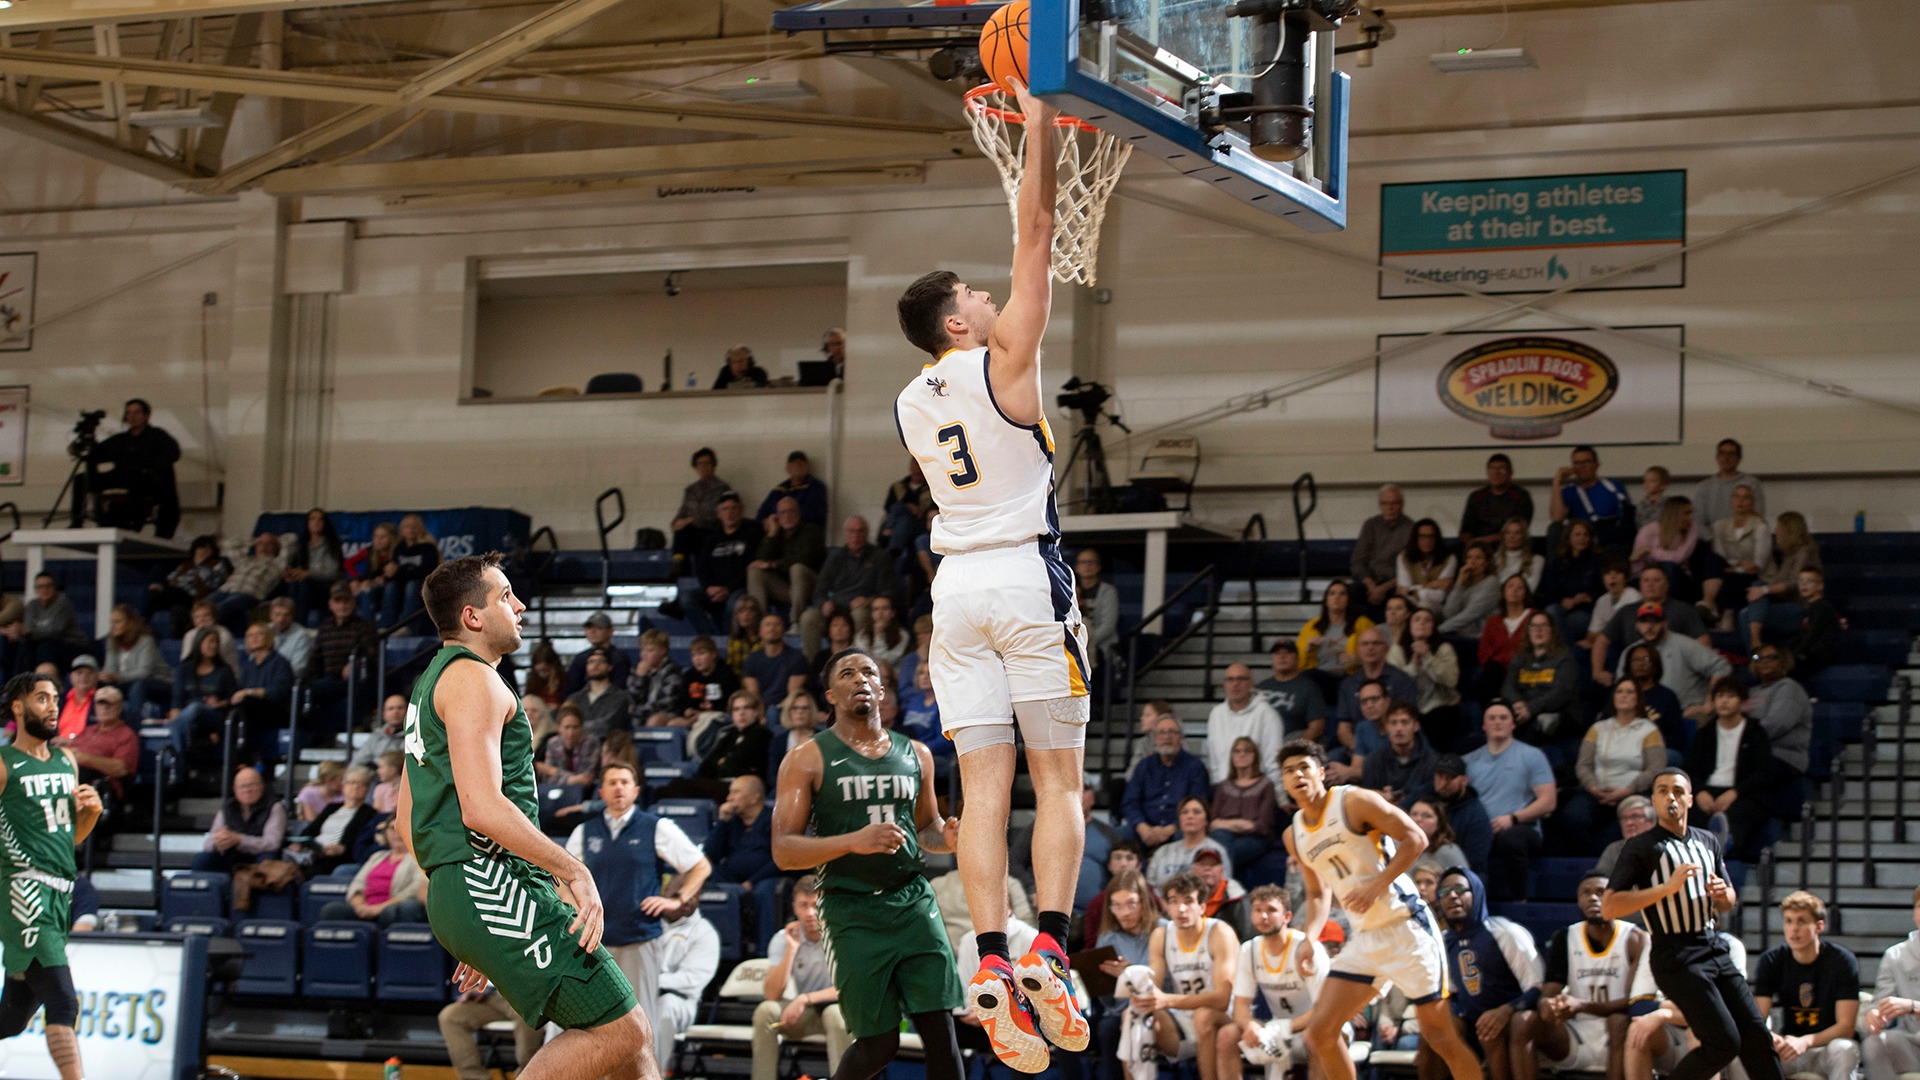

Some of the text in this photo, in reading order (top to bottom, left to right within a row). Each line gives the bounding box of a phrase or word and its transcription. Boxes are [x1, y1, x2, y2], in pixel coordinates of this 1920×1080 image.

[1421, 182, 1644, 216] Keeping athletes
[1447, 213, 1615, 241] at their best.
[1468, 355, 1584, 384] SPRADLIN BROS.
[1474, 381, 1579, 407] WELDING
[935, 420, 982, 491] 3
[19, 773, 76, 798] TIFFIN
[837, 775, 915, 802] TIFFIN
[40, 798, 71, 833] 14
[1328, 855, 1352, 880] 11
[1280, 997, 1294, 1014] 4
[1589, 984, 1610, 1003] 10
[27, 989, 166, 1045] KETS
